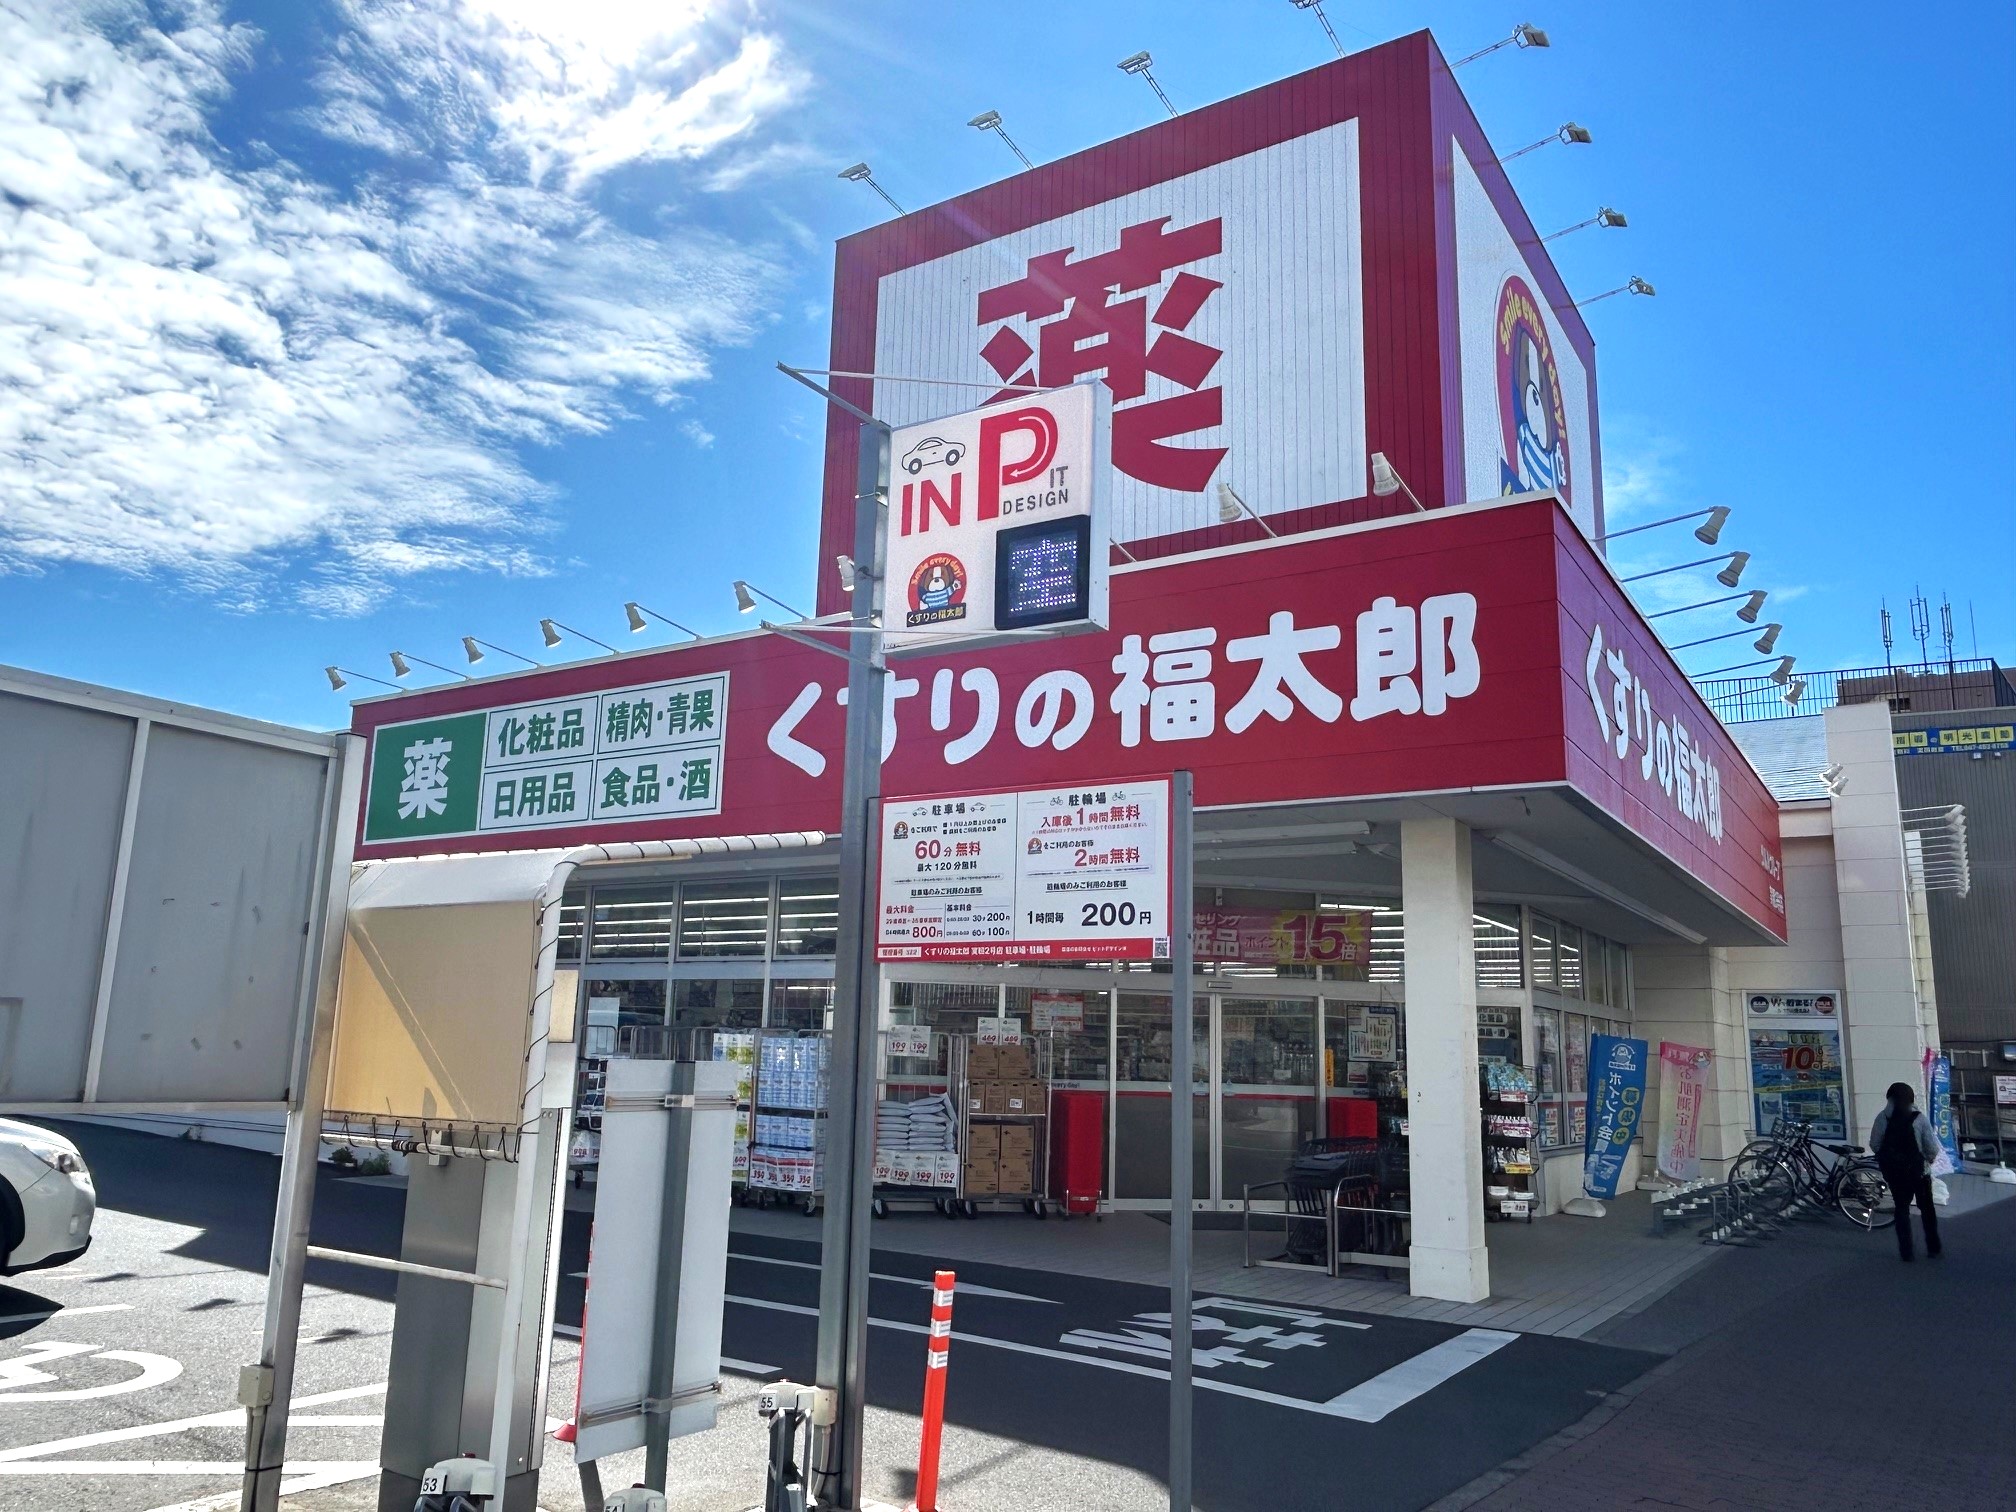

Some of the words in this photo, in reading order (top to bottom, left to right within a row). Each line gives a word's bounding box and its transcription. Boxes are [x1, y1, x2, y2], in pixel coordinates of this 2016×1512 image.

[901, 472, 962, 536] IN
[1003, 488, 1068, 515] DESIGN
[498, 708, 585, 758] 化粧品
[605, 689, 714, 743] 精肉・青果
[1586, 623, 1724, 846] くすりの福太郎
[397, 736, 452, 821] 薬
[493, 771, 576, 819] 日用品
[600, 757, 713, 809] 食品・酒
[931, 802, 966, 816] 駐車場
[1068, 792, 1107, 807] 駐輪場
[1081, 901, 1152, 927] 200円
[760, 1397, 773, 1408] 55
[422, 1477, 438, 1492] 53
